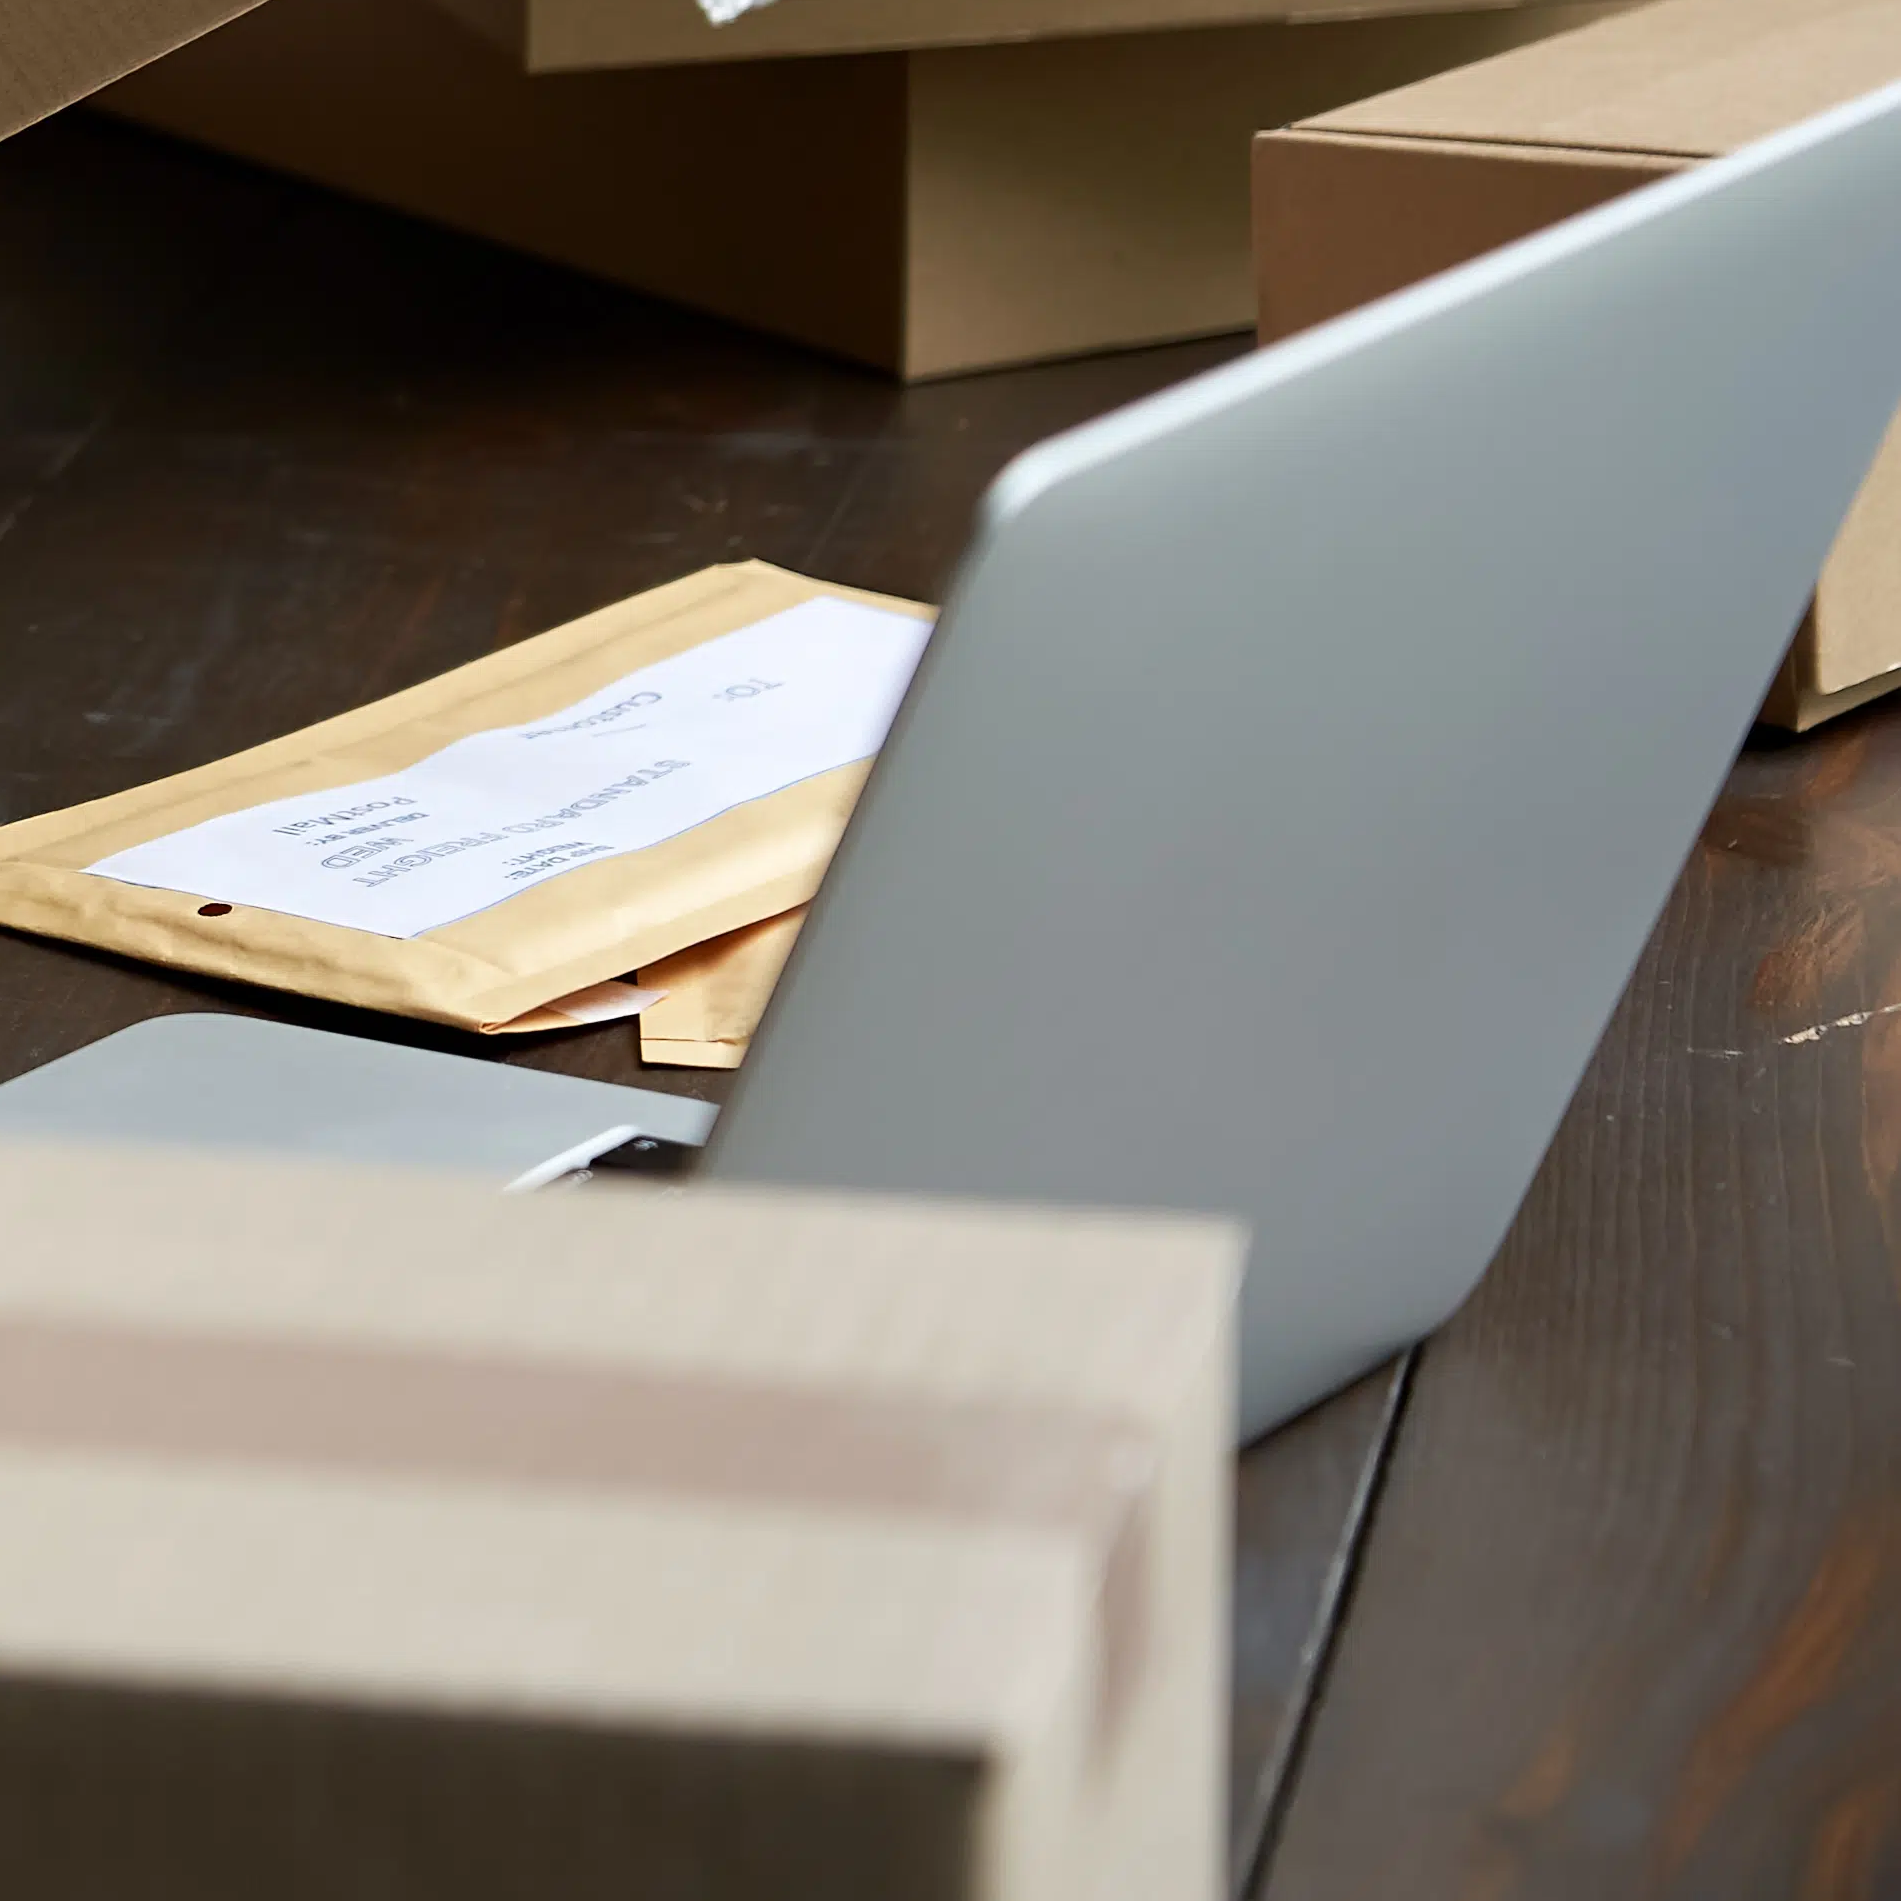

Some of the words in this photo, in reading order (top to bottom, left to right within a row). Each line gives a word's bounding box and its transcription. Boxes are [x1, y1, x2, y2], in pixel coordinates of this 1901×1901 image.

[711, 677, 785, 703] TO:
[517, 691, 663, 740] Customer
[272, 795, 418, 837] PostMail
[501, 758, 692, 835] STANDARD
[320, 836, 415, 870] WED
[352, 831, 510, 888] FREIGHT
[503, 856, 571, 880] DATE:
